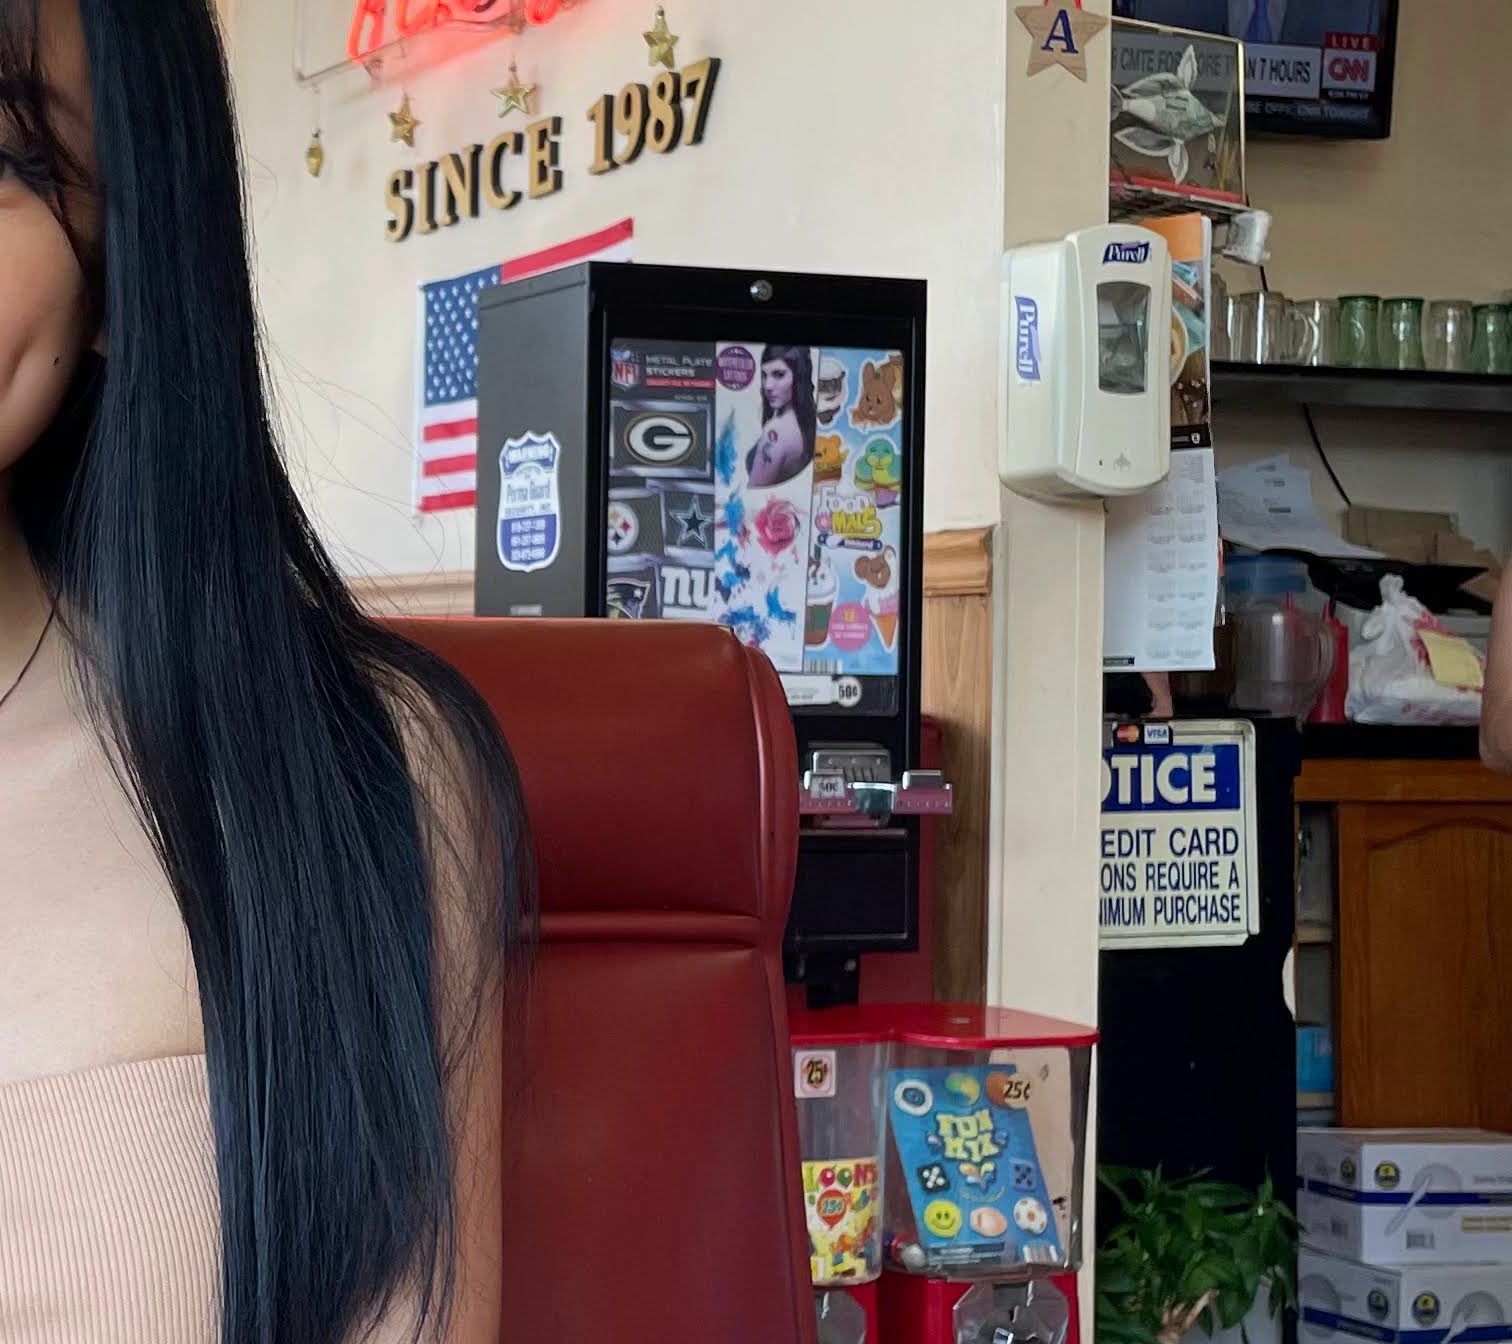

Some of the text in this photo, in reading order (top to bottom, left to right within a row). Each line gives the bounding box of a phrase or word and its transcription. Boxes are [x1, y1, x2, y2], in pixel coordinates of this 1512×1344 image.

[1331, 34, 1370, 50] LIVE
[1269, 58, 1311, 83] HOURS
[1327, 56, 1370, 83] CNN
[385, 57, 721, 242] SINCE 1987
[646, 354, 679, 367] METAL
[681, 355, 713, 368] PLATE
[646, 367, 696, 377] STICKERS
[1146, 728, 1168, 739] VISA
[1101, 752, 1217, 805] TICE
[1101, 827, 1238, 858] EDIT CARD
[1145, 860, 1220, 891] REQUIRE
[1228, 860, 1240, 890] A
[1154, 894, 1241, 926] PURCHASE
[1003, 1080, 1032, 1100] 25¢
